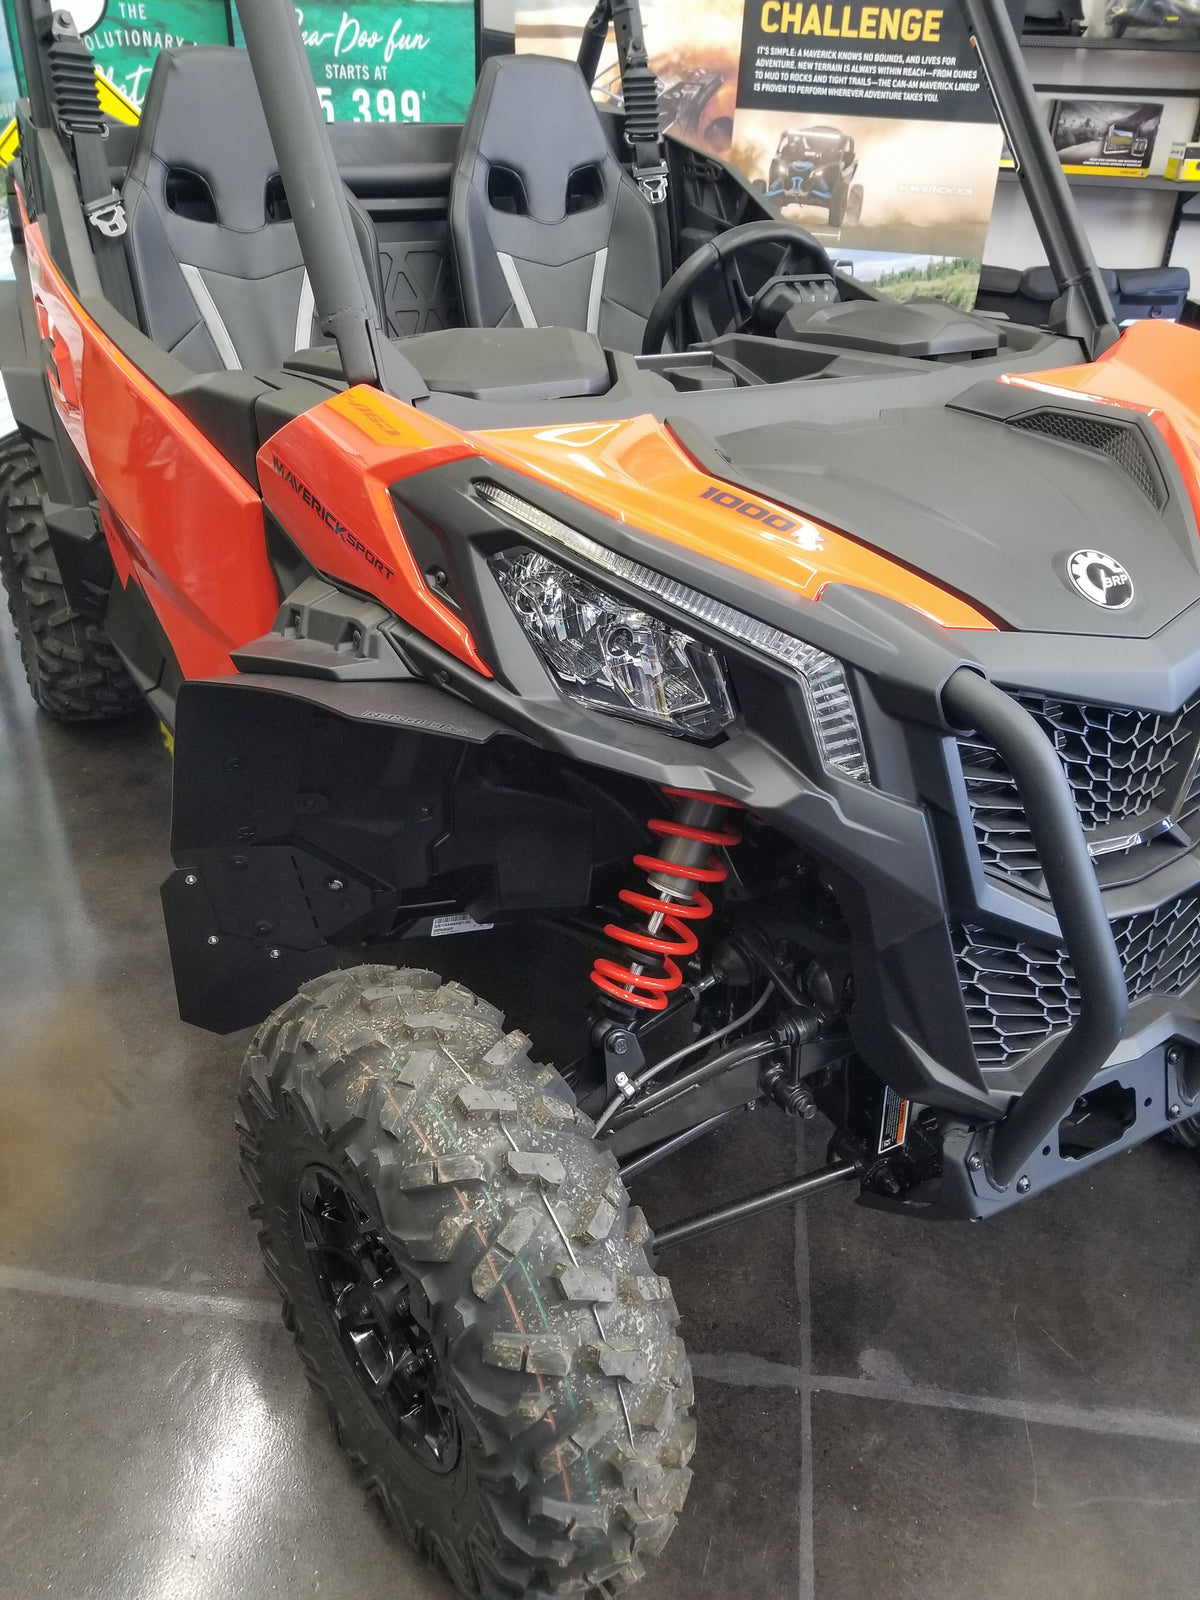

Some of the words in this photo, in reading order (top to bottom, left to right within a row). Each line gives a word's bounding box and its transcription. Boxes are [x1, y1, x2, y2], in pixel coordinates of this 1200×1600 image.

[119, 3, 147, 20] THE
[760, 1, 944, 43] CHALLENGE
[83, 30, 184, 51] OLUTIONARY
[384, 18, 430, 63] fun
[757, 46, 770, 55] IT'S
[770, 46, 797, 57] SIMPLE:
[797, 48, 802, 57] A
[803, 48, 837, 60] MAVERICK
[838, 50, 862, 61] KNOWS
[863, 53, 874, 62] NO
[874, 53, 904, 64] BOUNDS,
[905, 55, 920, 64] AND
[921, 55, 941, 65] LIVES
[941, 56, 956, 66] FOR
[325, 64, 370, 80] STARTS
[374, 66, 388, 81] AT
[755, 58, 797, 70] ADVENTURE.
[797, 61, 814, 70] NEW
[814, 62, 843, 72] TERRAIN
[843, 63, 850, 73] IS
[851, 64, 877, 74] ALWAYS
[877, 66, 902, 76] WITHIN
[953, 69, 977, 79] DUNES
[754, 70, 763, 80] TO
[764, 71, 780, 80] MUD
[780, 72, 789, 81] TO
[789, 72, 813, 83] ROCKS
[813, 74, 828, 84] AND
[828, 75, 848, 85] TIGHT
[892, 79, 918, 89] CAN-AM
[919, 80, 954, 91] MAVERICK
[954, 82, 980, 92] LINEUP
[753, 83, 760, 92] IS
[761, 83, 787, 94] PROVEN
[787, 85, 796, 94] TO
[796, 85, 828, 96] PERFORM
[828, 87, 864, 98] WHEREVER
[864, 90, 902, 101] ADVENTURE
[903, 92, 923, 102] TAKES
[923, 93, 939, 103] YOU.
[1104, 574, 1128, 589] BRP
